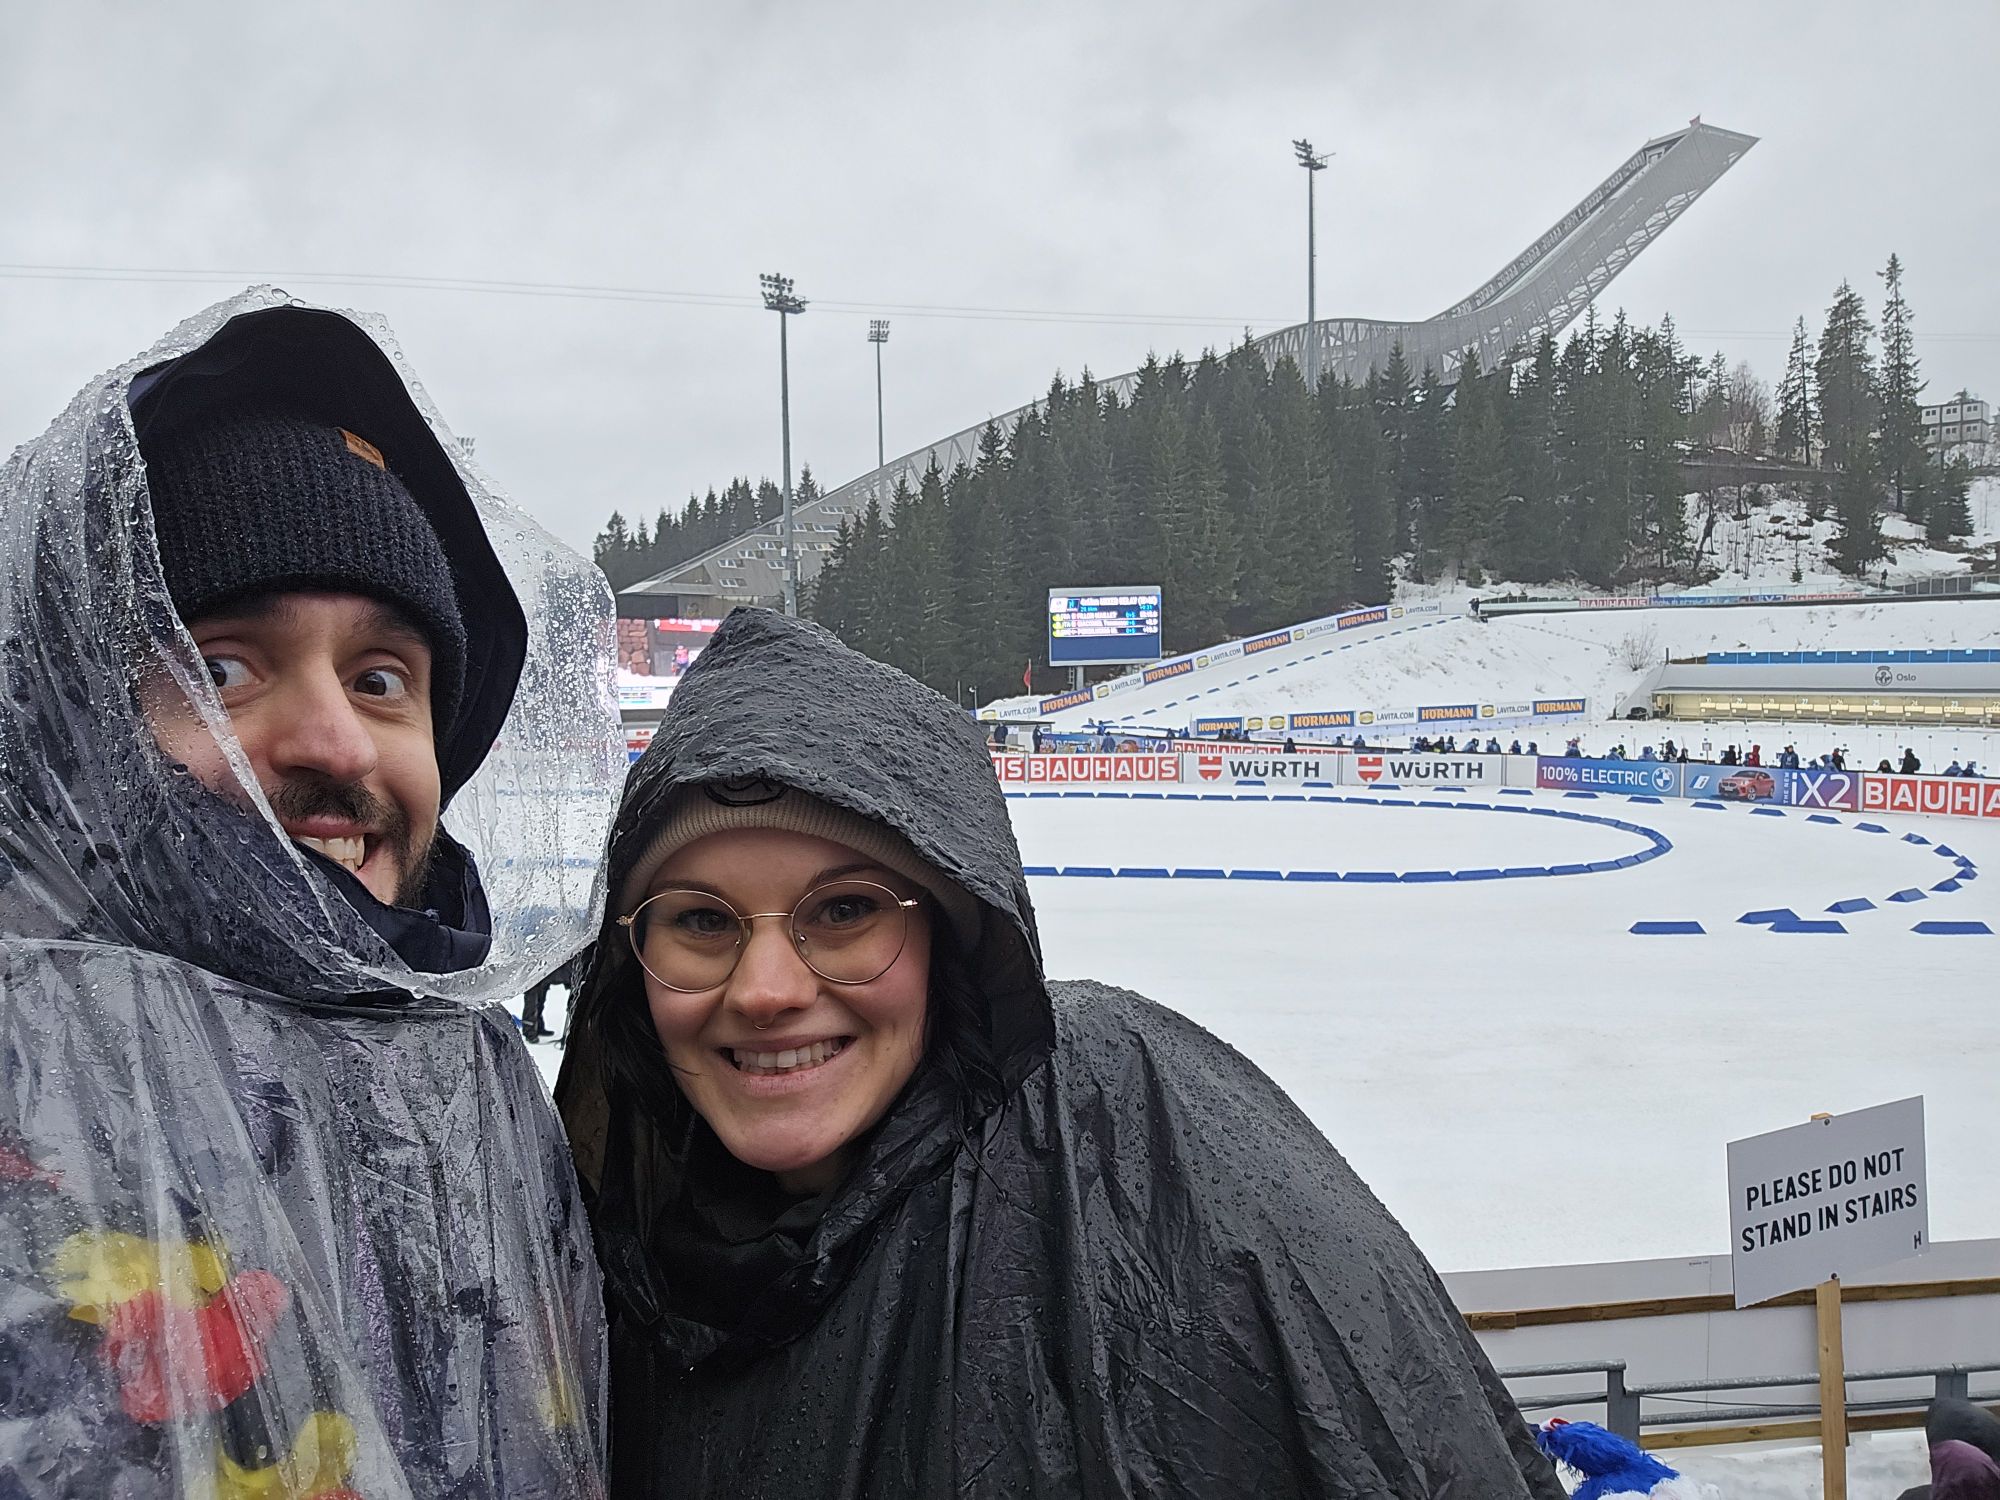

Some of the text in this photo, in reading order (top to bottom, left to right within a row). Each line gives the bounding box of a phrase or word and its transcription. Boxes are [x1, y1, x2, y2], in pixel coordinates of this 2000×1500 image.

[1405, 605, 1439, 615] LAVITA.COM
[1210, 647, 1242, 662] LAVITA.COM
[1111, 677, 1142, 692] LAVITA.COM
[1896, 673, 1917, 682] Oslo
[1000, 706, 1037, 718] LAVITA.COM
[1376, 711, 1415, 721] LAVITA.COM
[1496, 704, 1530, 715] LAVITA.COM
[1030, 758, 1177, 779] BAUHAUS
[1542, 766, 1578, 782] 100%
[1581, 768, 1649, 786] ELECTRIC
[1791, 772, 1852, 808] iX2
[1746, 1148, 1905, 1211] PLEASE DO NOT
[1742, 1183, 1918, 1253] STAND IN STAIRS
